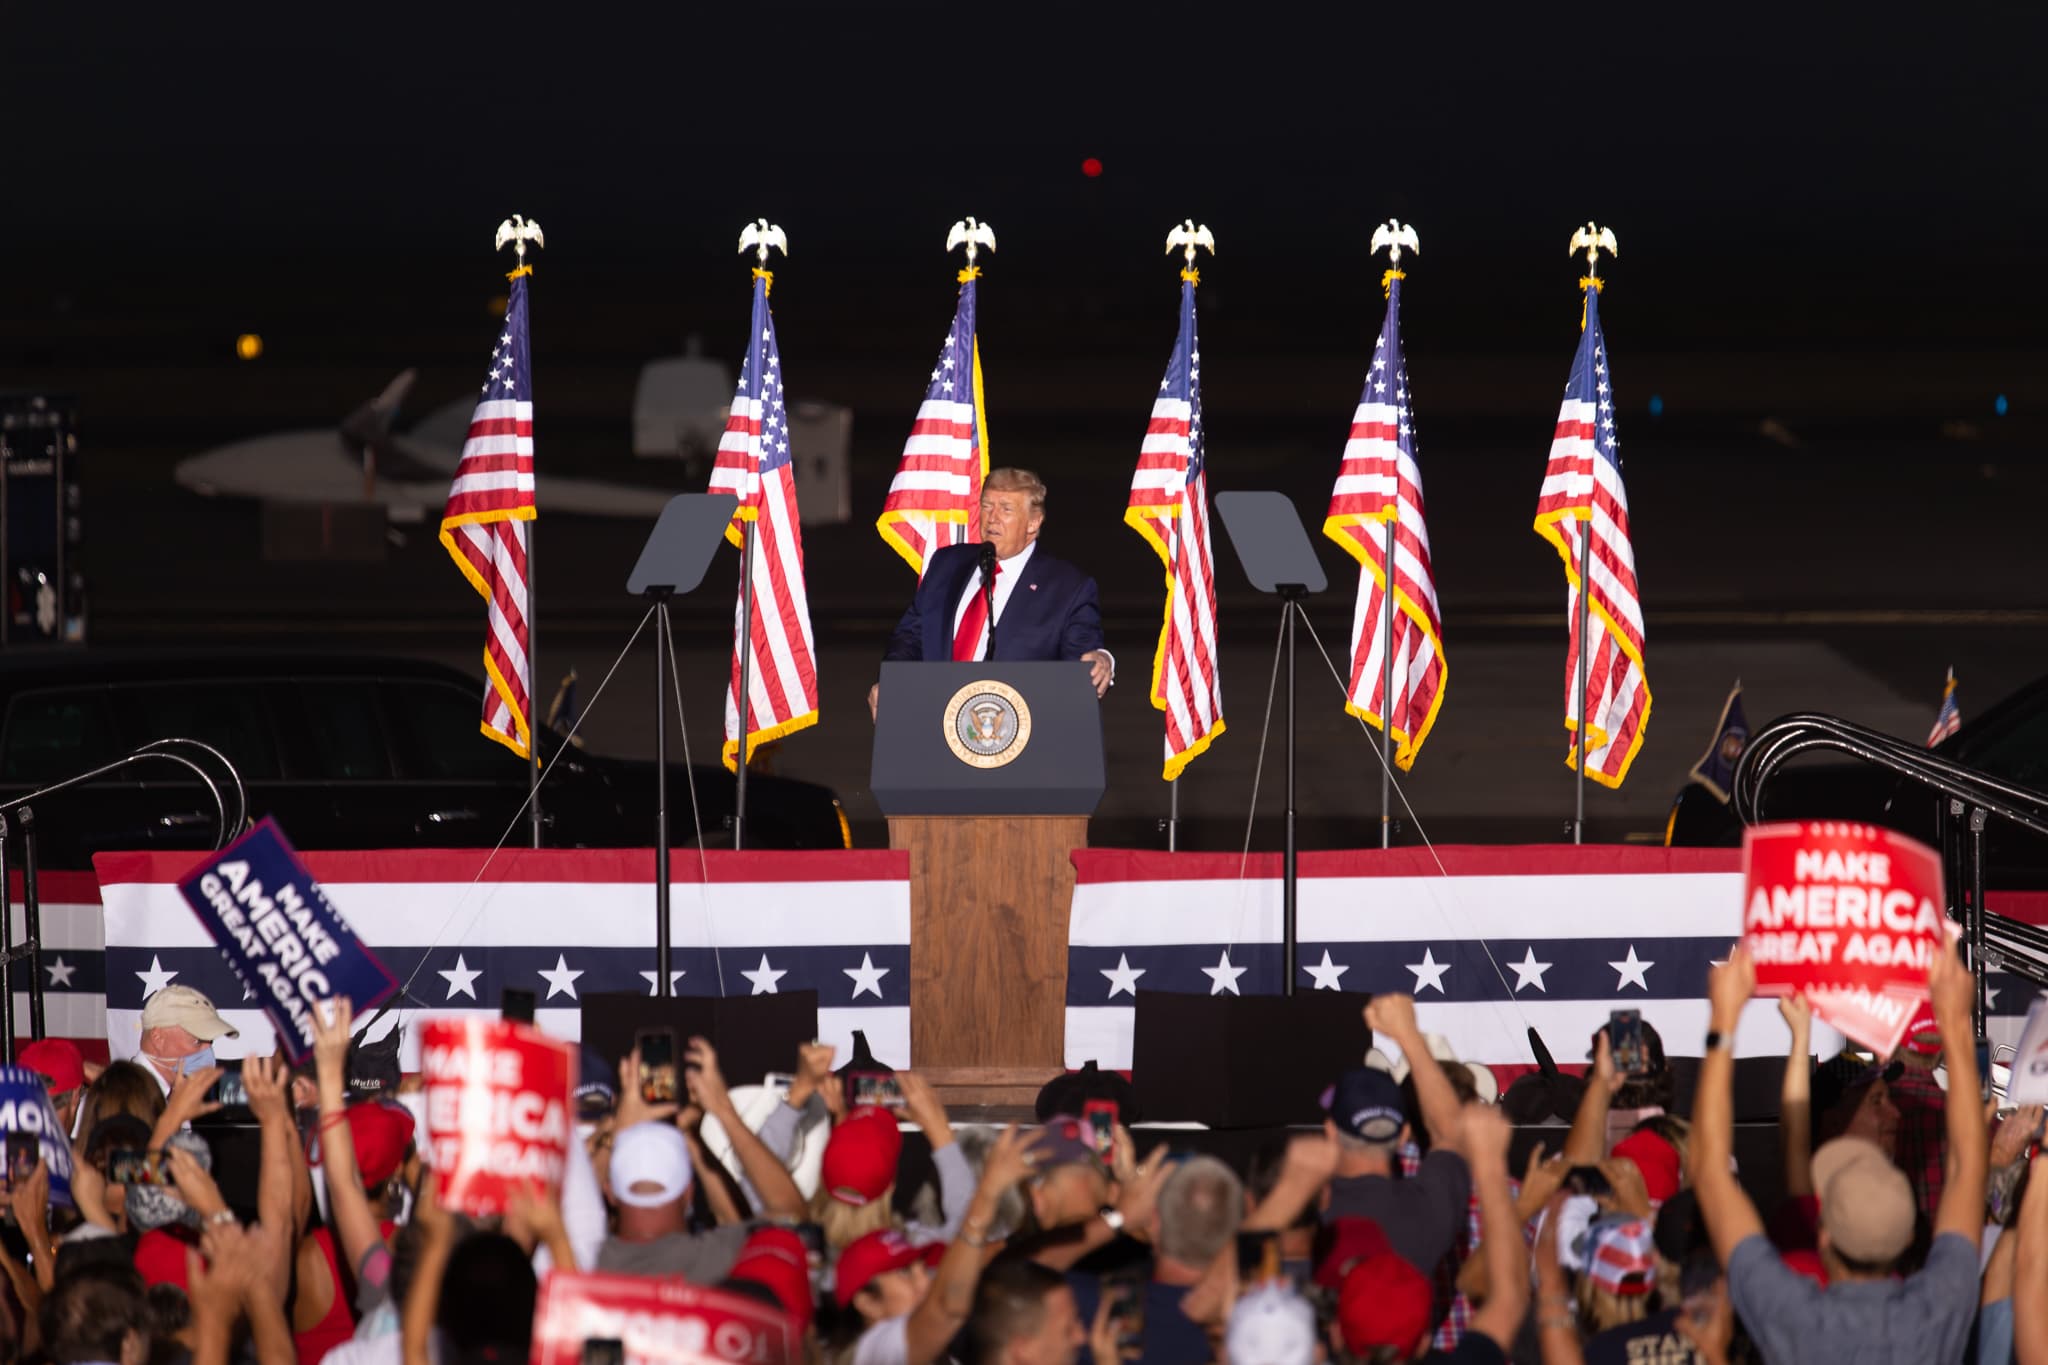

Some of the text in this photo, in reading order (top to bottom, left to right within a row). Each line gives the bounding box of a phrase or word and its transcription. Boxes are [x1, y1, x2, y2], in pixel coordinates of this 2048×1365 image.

[1795, 848, 1892, 885] MAKE
[200, 871, 267, 959] GREAT
[275, 882, 340, 966] MAKE
[1747, 884, 1946, 940] AMERICA
[422, 1045, 524, 1087] MAE
